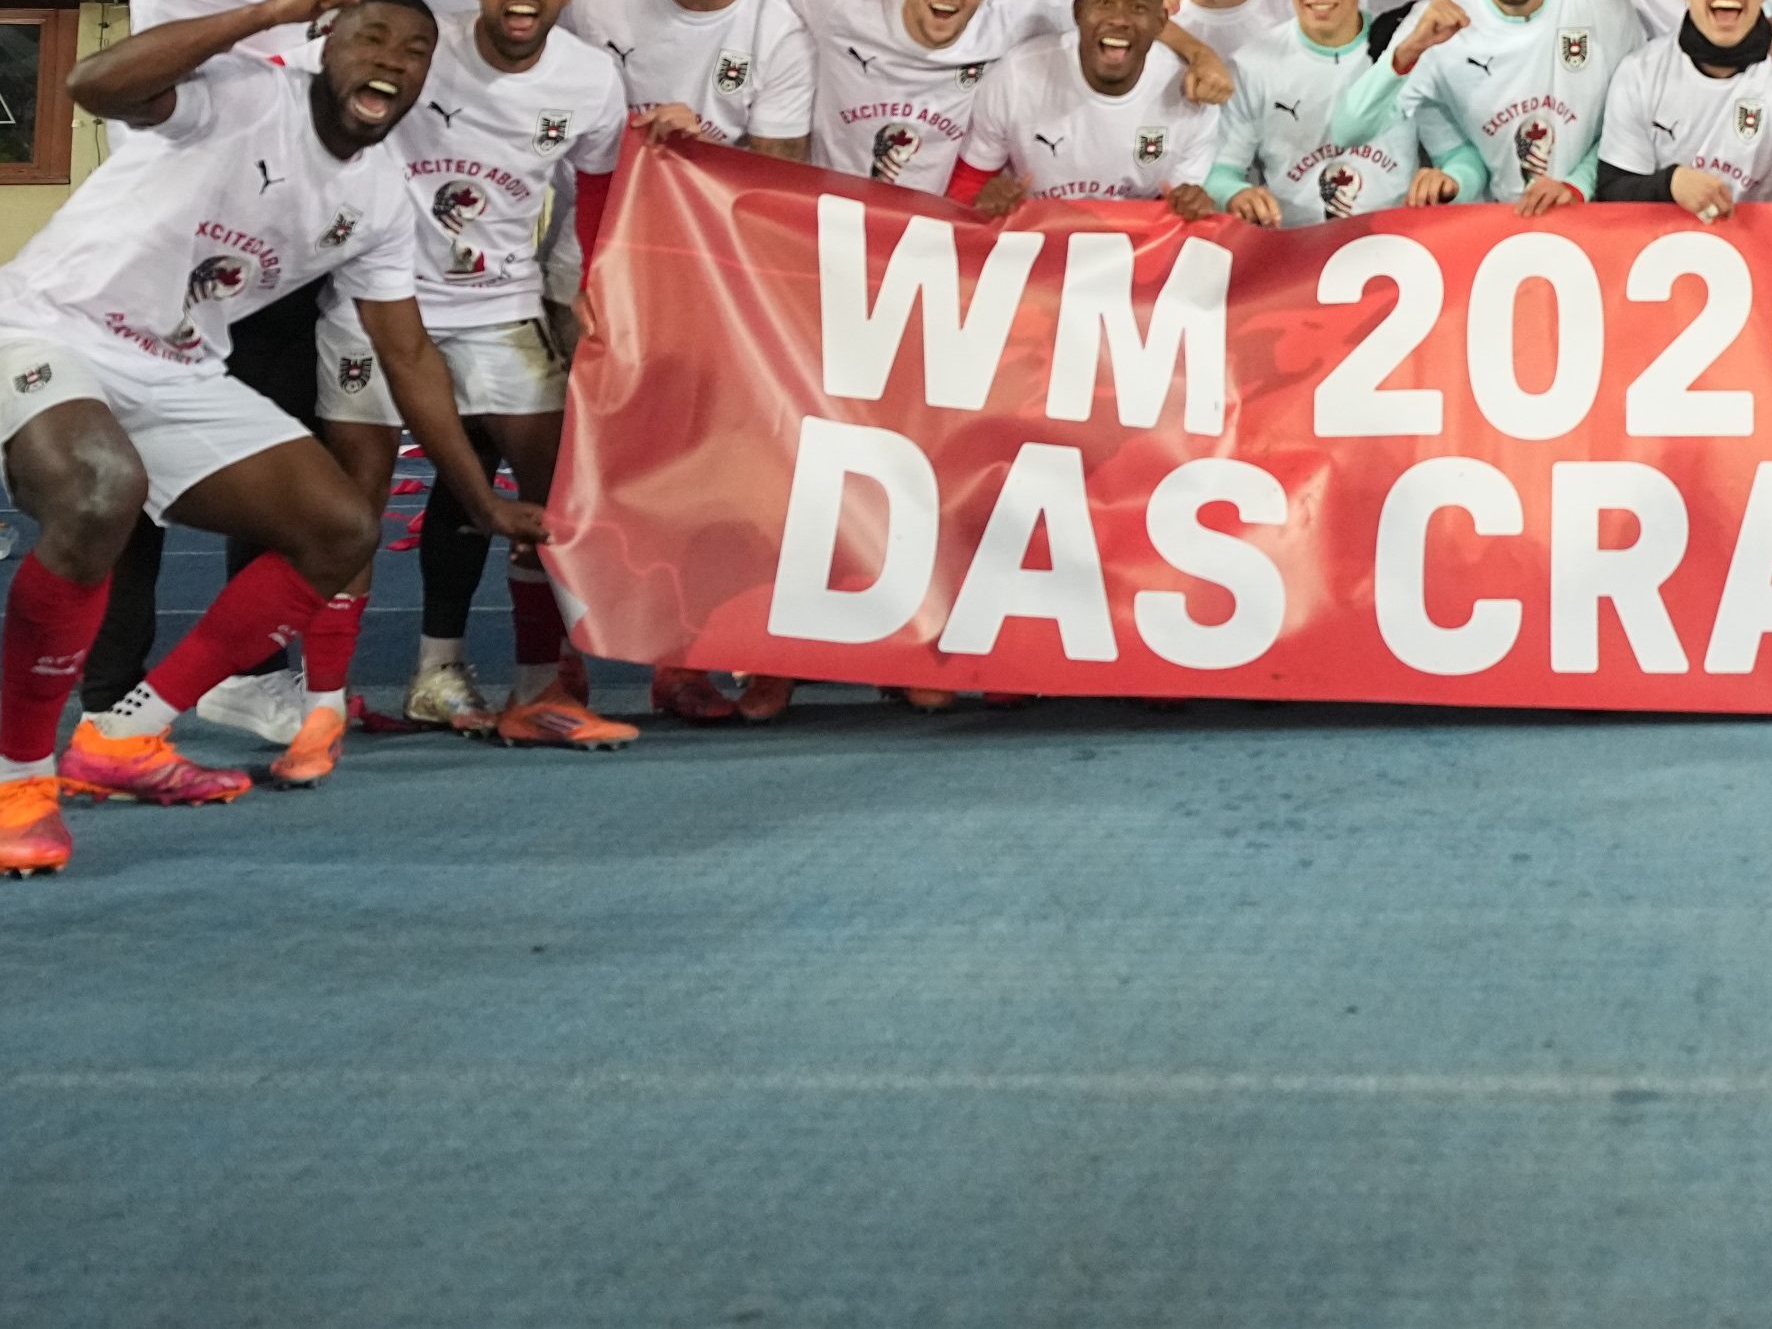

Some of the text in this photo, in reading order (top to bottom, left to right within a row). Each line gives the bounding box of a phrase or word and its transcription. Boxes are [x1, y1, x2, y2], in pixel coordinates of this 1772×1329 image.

[839, 102, 967, 143] EXCITED ABOUT
[1482, 99, 1538, 138] EXCITED
[1285, 143, 1399, 183] EXCITED ABOUT
[483, 166, 532, 202] ABOUT
[196, 220, 263, 255] XCITED
[818, 192, 1234, 437] WM
[766, 415, 1289, 670] DAS
